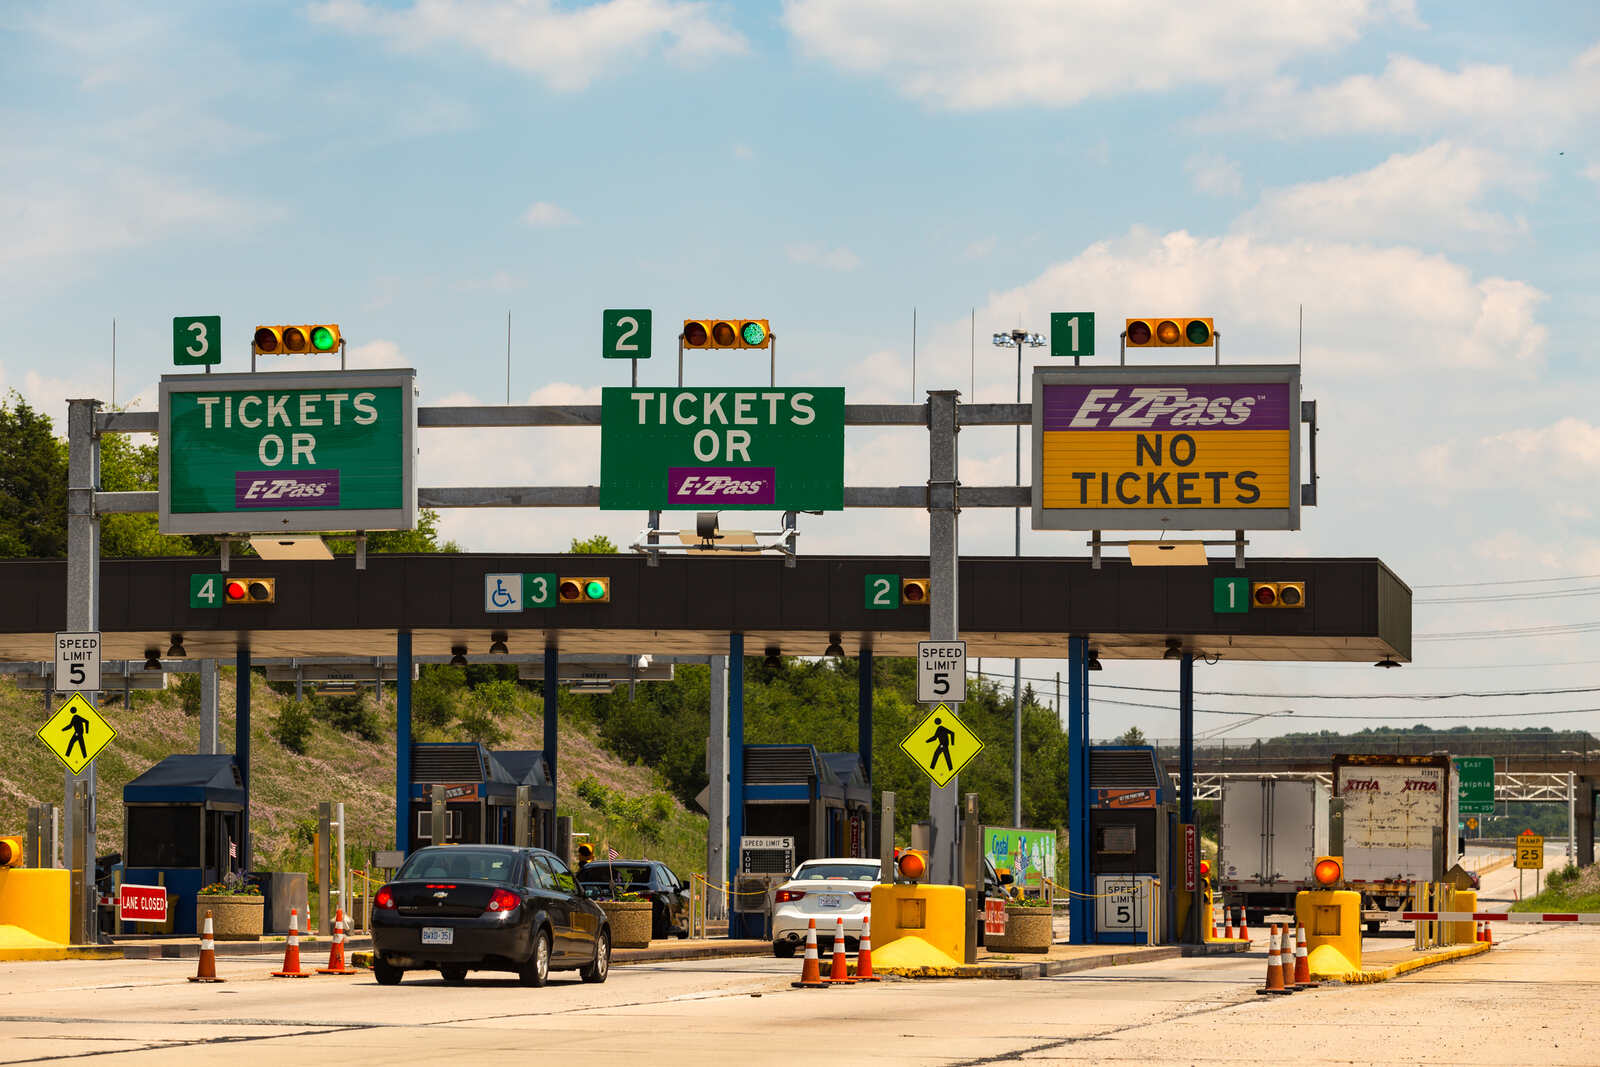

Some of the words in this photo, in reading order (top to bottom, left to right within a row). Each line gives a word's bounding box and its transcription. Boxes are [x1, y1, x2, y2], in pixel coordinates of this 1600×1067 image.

[186, 322, 209, 357] 3
[616, 316, 639, 351] 2
[1067, 316, 1079, 351] 1
[197, 392, 378, 429] TICKETS
[631, 392, 816, 425] TICKETS
[1068, 388, 1256, 428] E-ZPass
[258, 433, 317, 467] OR
[693, 429, 752, 462] OR
[1136, 433, 1197, 467] NO
[244, 479, 328, 500] E-ZPass
[677, 476, 762, 495] E-ZPass
[1072, 471, 1261, 505] TICKETS
[197, 578, 215, 604] 4
[531, 576, 548, 603] 3
[873, 579, 890, 605] 2
[1227, 581, 1235, 608] 1
[59, 639, 97, 649] SPEED
[63, 651, 92, 661] LIMIT
[922, 648, 962, 658] SPEED
[70, 664, 85, 684] 5
[926, 660, 957, 671] LIMIT
[933, 673, 950, 695] 5
[1343, 779, 1380, 793] XTRA
[1400, 780, 1438, 793] XTRA
[782, 838, 790, 848] 5
[1520, 849, 1539, 860] 25
[123, 895, 139, 910] LANE
[141, 896, 165, 911] CLOSED
[1117, 906, 1131, 923] 5
